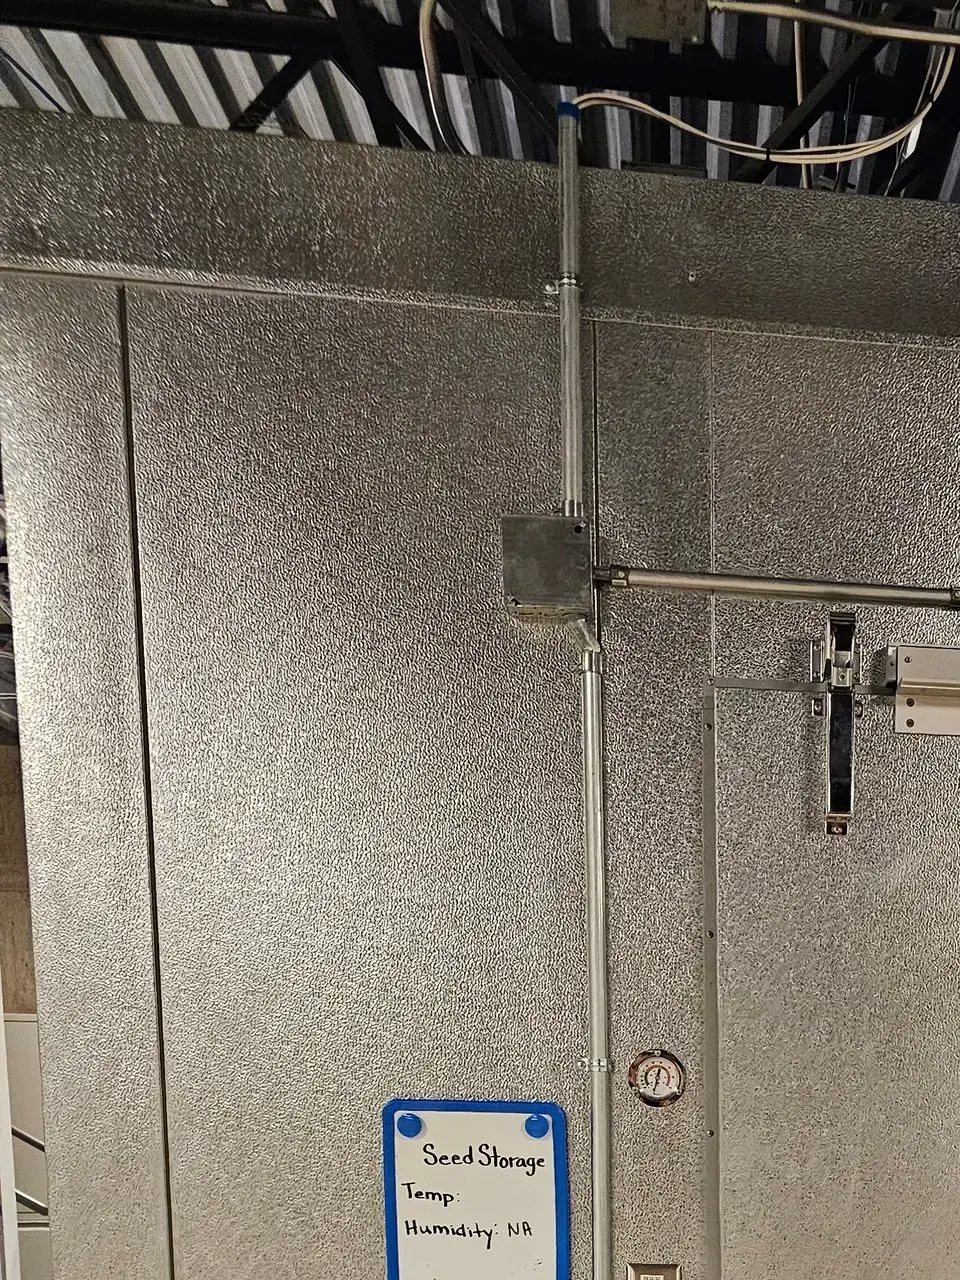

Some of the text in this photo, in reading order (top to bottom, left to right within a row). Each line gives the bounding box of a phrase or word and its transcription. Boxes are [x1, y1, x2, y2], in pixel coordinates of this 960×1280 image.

[422, 1143, 546, 1177] Seed Storage
[401, 1182, 461, 1207] Temp:
[404, 1219, 533, 1250] Humidity: NA
